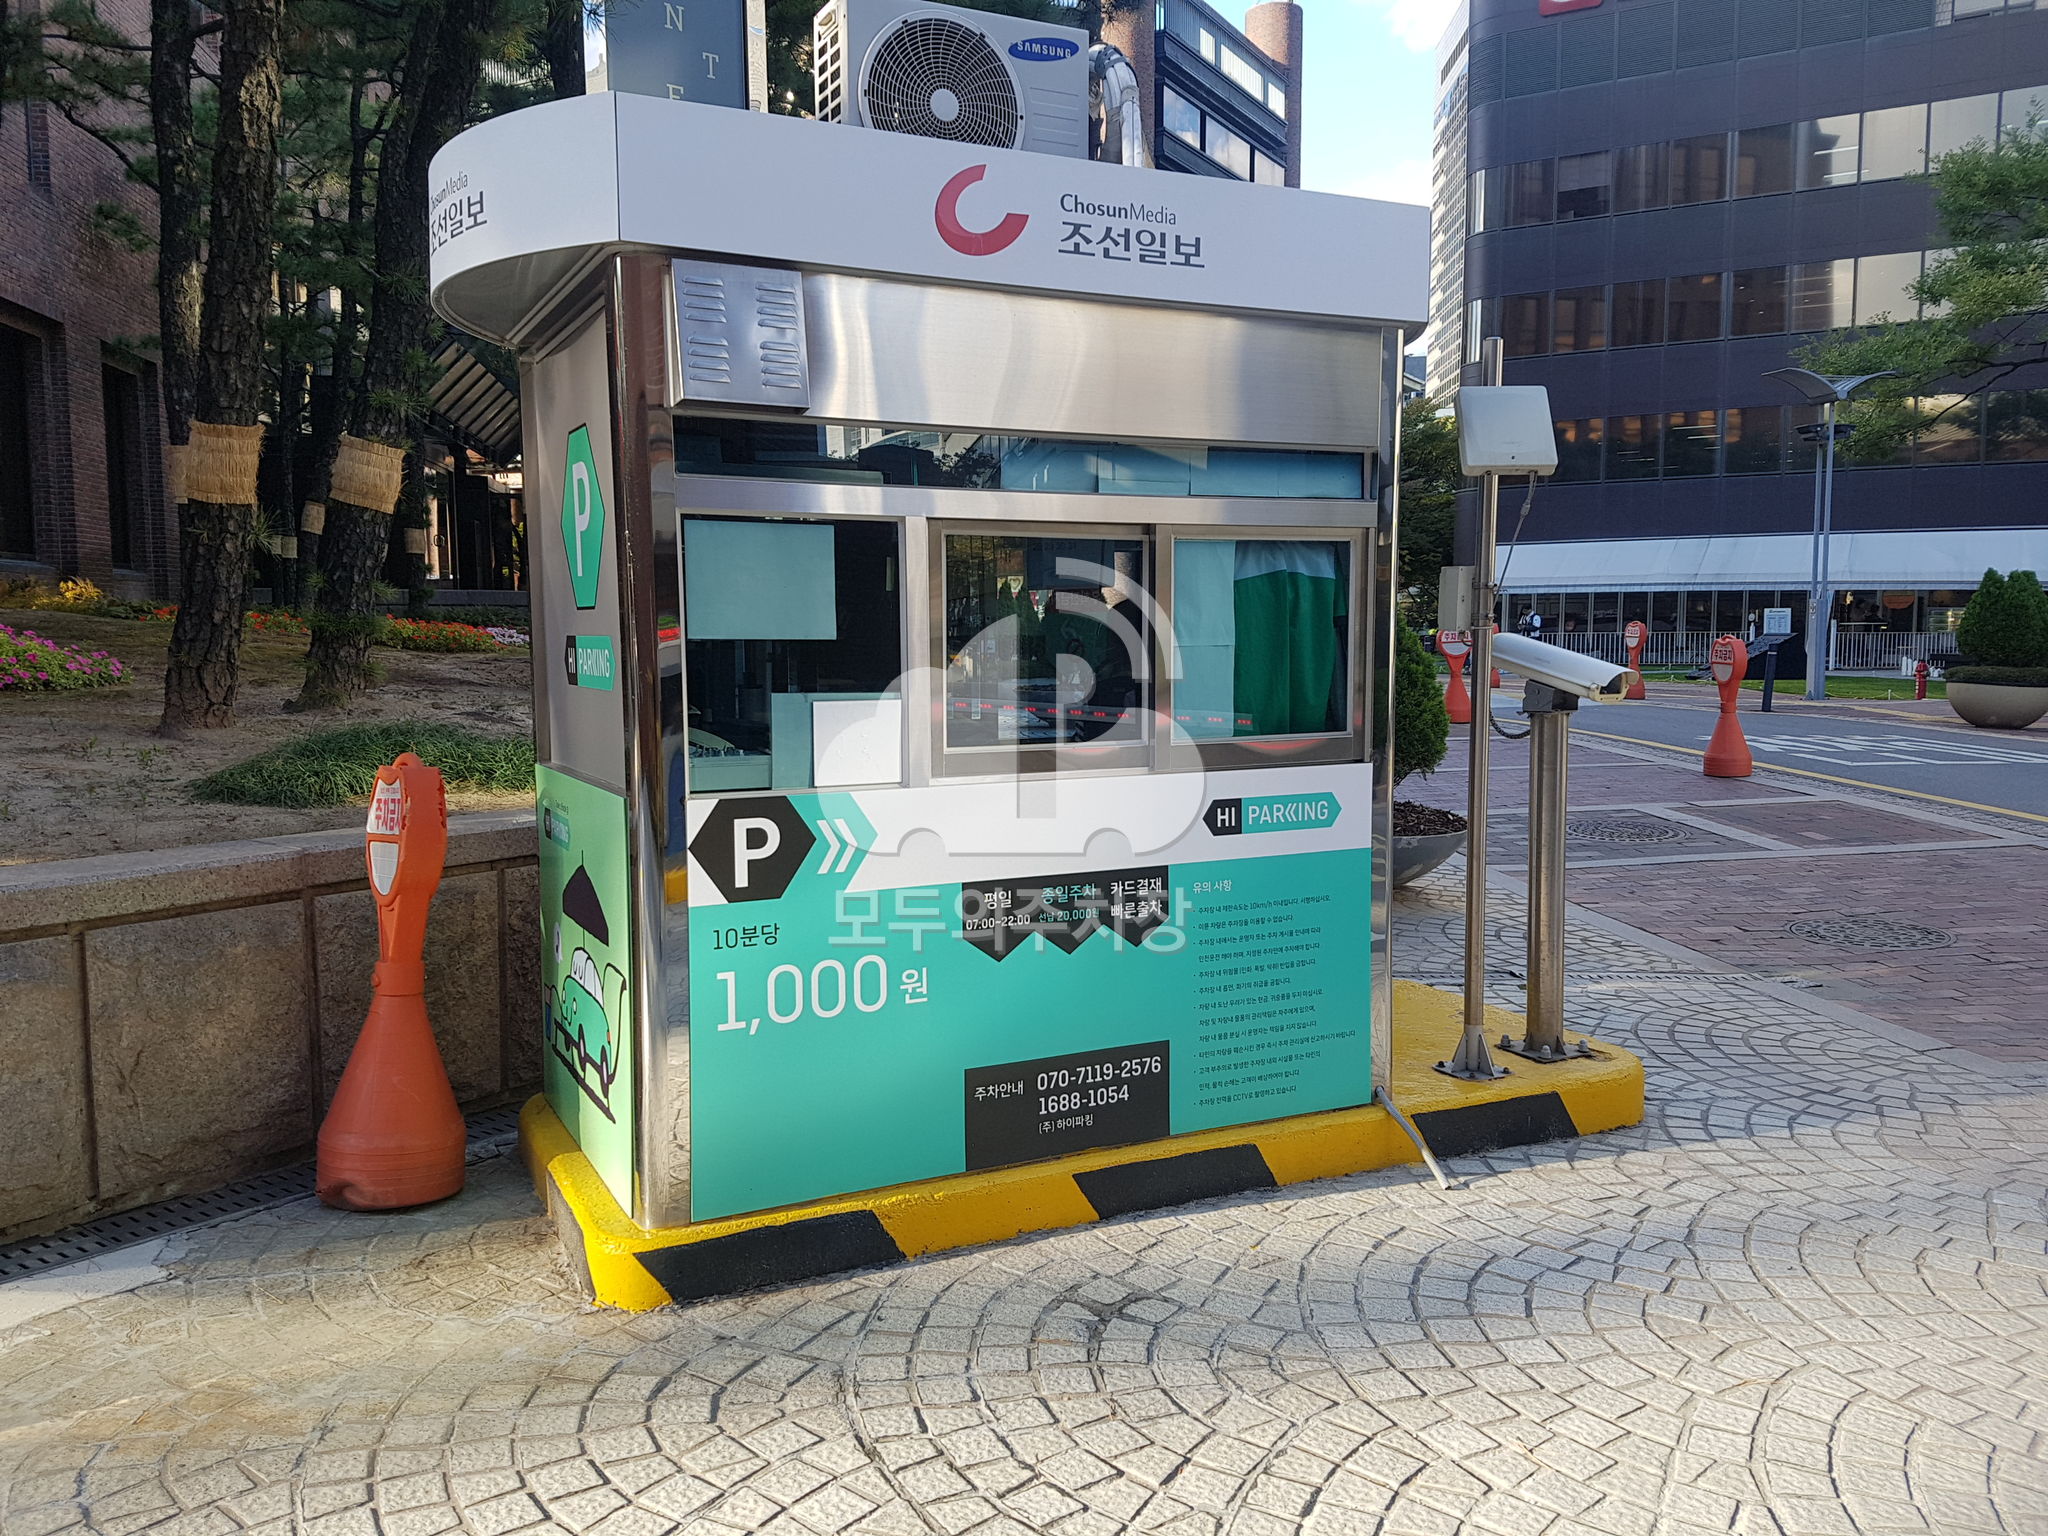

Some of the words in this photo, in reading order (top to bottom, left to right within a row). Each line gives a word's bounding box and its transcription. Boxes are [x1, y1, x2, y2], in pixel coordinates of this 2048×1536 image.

[1017, 41, 1072, 60] SAMSUNG
[1060, 193, 1177, 225] ChosunMedia
[1058, 221, 1205, 268] 조선일보
[572, 461, 591, 577] P
[567, 647, 576, 674] HI
[578, 648, 610, 678] PARKING
[1217, 806, 1235, 828] HI
[1248, 800, 1329, 825] PARKING
[733, 817, 781, 888] P
[984, 890, 1011, 909] 평일
[1041, 883, 1096, 904] 종일주차
[1110, 877, 1162, 897] 카드결재
[1193, 881, 1211, 893] 유의
[1214, 879, 1232, 892] 사항
[966, 914, 1031, 931] 07:00~22:00
[1110, 899, 1162, 920] 빠른출차
[713, 923, 780, 950] 10분당
[716, 954, 888, 1036] 1,000
[899, 967, 928, 1004] 원
[1037, 1056, 1162, 1091] 070-7119-2576
[973, 1080, 1024, 1102] 주차안내
[1039, 1085, 1130, 1115] 1688-1054
[1038, 1120, 1055, 1134] (주)
[1056, 1114, 1094, 1131] 하이파킹
